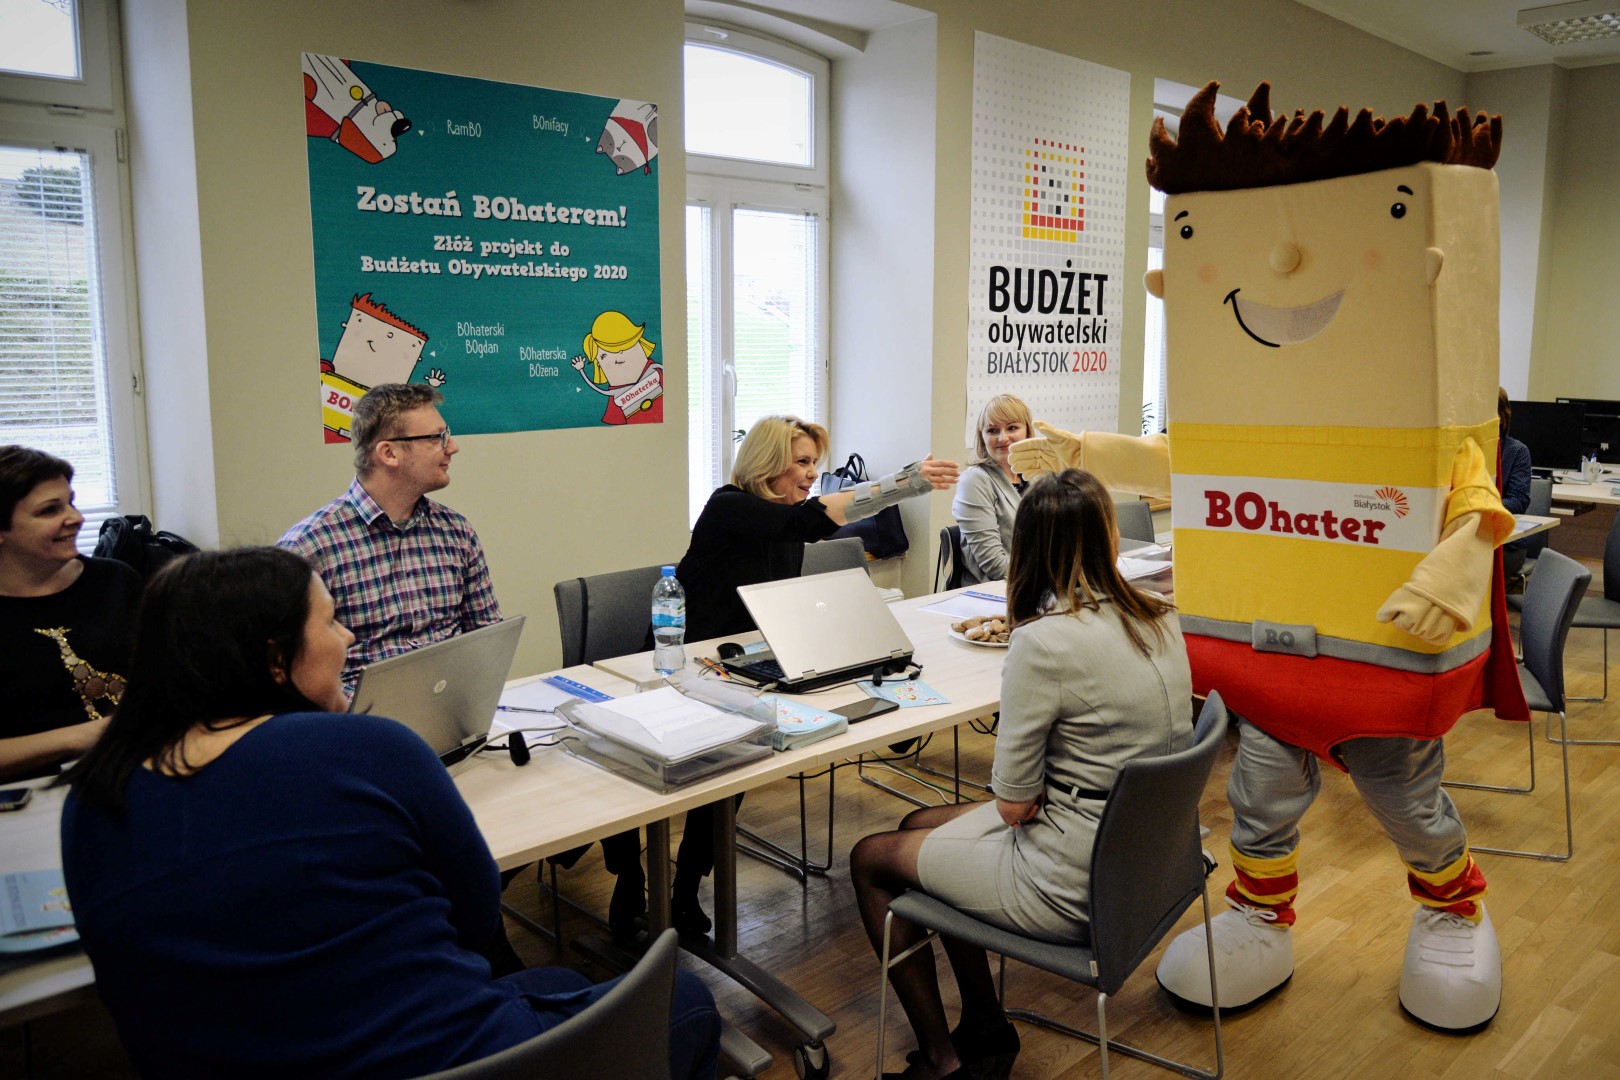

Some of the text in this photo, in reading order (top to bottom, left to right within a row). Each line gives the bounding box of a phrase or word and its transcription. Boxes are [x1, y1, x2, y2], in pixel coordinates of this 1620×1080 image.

[447, 119, 482, 138] RamBO
[532, 114, 569, 137] BOnifacy
[357, 186, 628, 228] Zostań BOhaterem!
[433, 235, 571, 259] Złóż projekt do
[360, 256, 628, 283] Budżetu Obywatelskiego 2020
[988, 259, 1109, 316] BUDŻET
[457, 321, 505, 337] BOhaterski
[988, 315, 1108, 351] obywatelski
[465, 339, 499, 358] BOgdan
[519, 346, 567, 361] BOhaterska
[529, 363, 559, 378] BOżena
[987, 351, 1108, 374] BIAŁYSTOK 2020
[327, 391, 353, 412] BO
[620, 377, 658, 405] BOhaterka
[1354, 499, 1391, 511] Białystok
[1204, 490, 1386, 544] BOhater
[1265, 628, 1295, 648] BO
